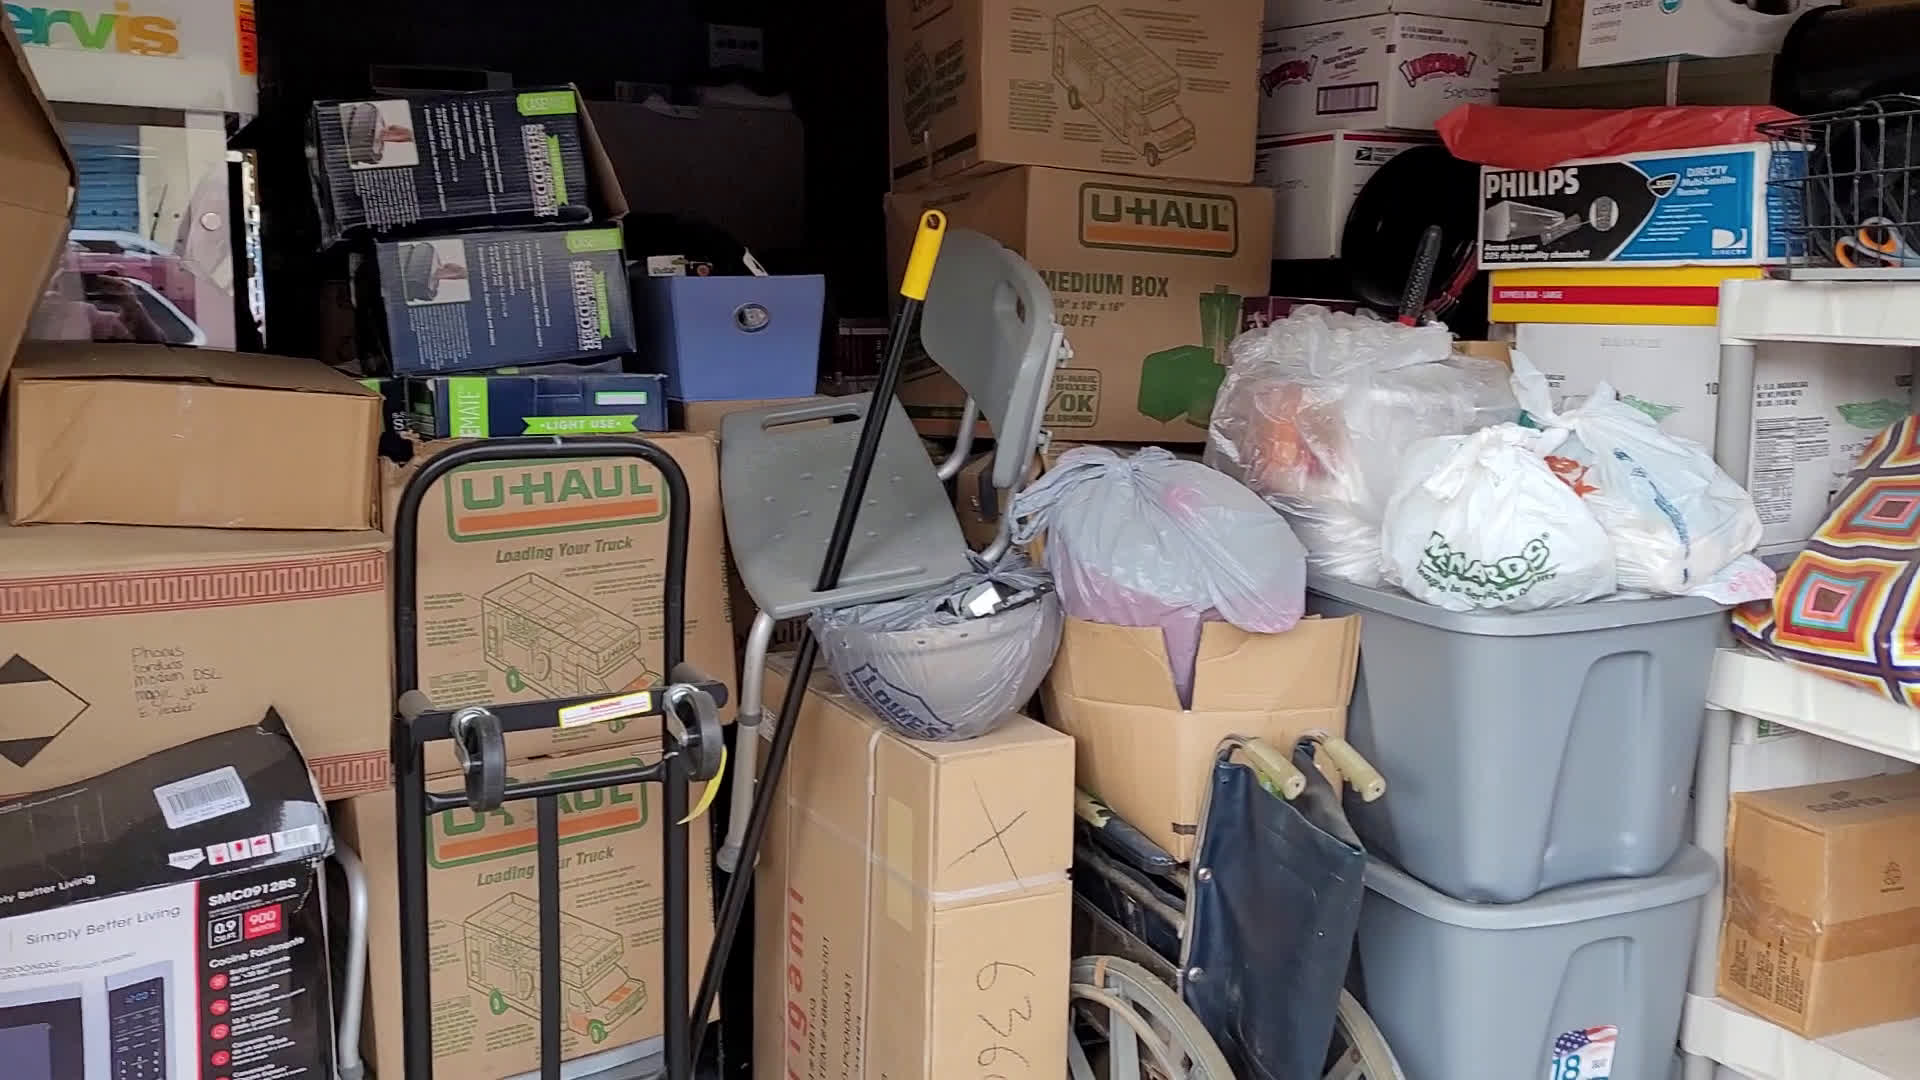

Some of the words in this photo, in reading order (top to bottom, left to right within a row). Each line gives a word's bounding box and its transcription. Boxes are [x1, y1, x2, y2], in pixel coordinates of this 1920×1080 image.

[1485, 168, 1580, 198] PHILIPS
[1131, 275, 1169, 298] BOX
[572, 260, 595, 351] SHREDDER
[1081, 315, 1097, 327] FT
[1060, 394, 1094, 412] OK
[545, 419, 585, 431] LIGHT
[591, 418, 617, 429] USE
[461, 464, 653, 510] U-HAUL
[496, 545, 554, 564] Loading
[559, 542, 591, 557] Your
[595, 536, 633, 552] Truck
[192, 667, 224, 681] DSL
[477, 864, 535, 886] Loading
[576, 846, 615, 865] Truck
[18, 885, 56, 900] Better
[58, 874, 96, 891] Living
[208, 877, 297, 907] SMC0912BS
[25, 929, 81, 946] Simply
[87, 916, 134, 936] Better
[137, 906, 182, 924] Living
